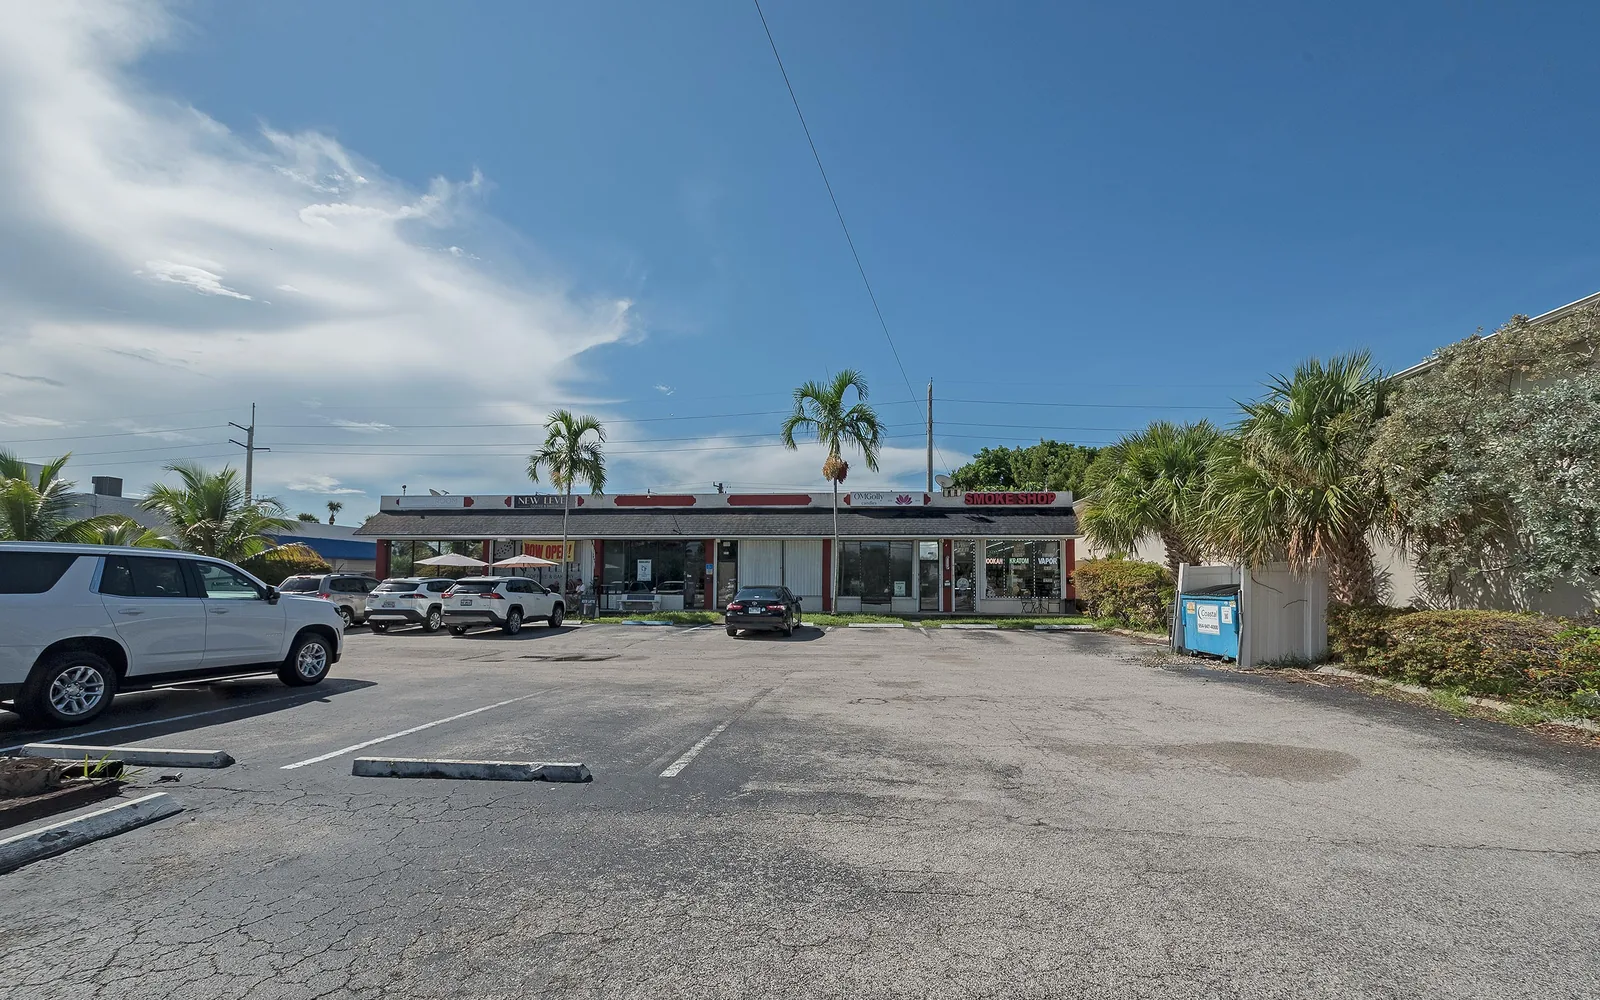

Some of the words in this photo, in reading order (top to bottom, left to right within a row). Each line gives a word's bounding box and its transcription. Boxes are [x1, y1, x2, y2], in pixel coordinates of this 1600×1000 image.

[518, 497, 539, 505] NEW
[543, 497, 566, 505] LEVE
[965, 493, 1013, 505] SMOKE
[1017, 493, 1056, 505] SHOP
[524, 543, 543, 558] NOW
[545, 544, 572, 558] OPE!
[1201, 609, 1217, 617] Coastal
